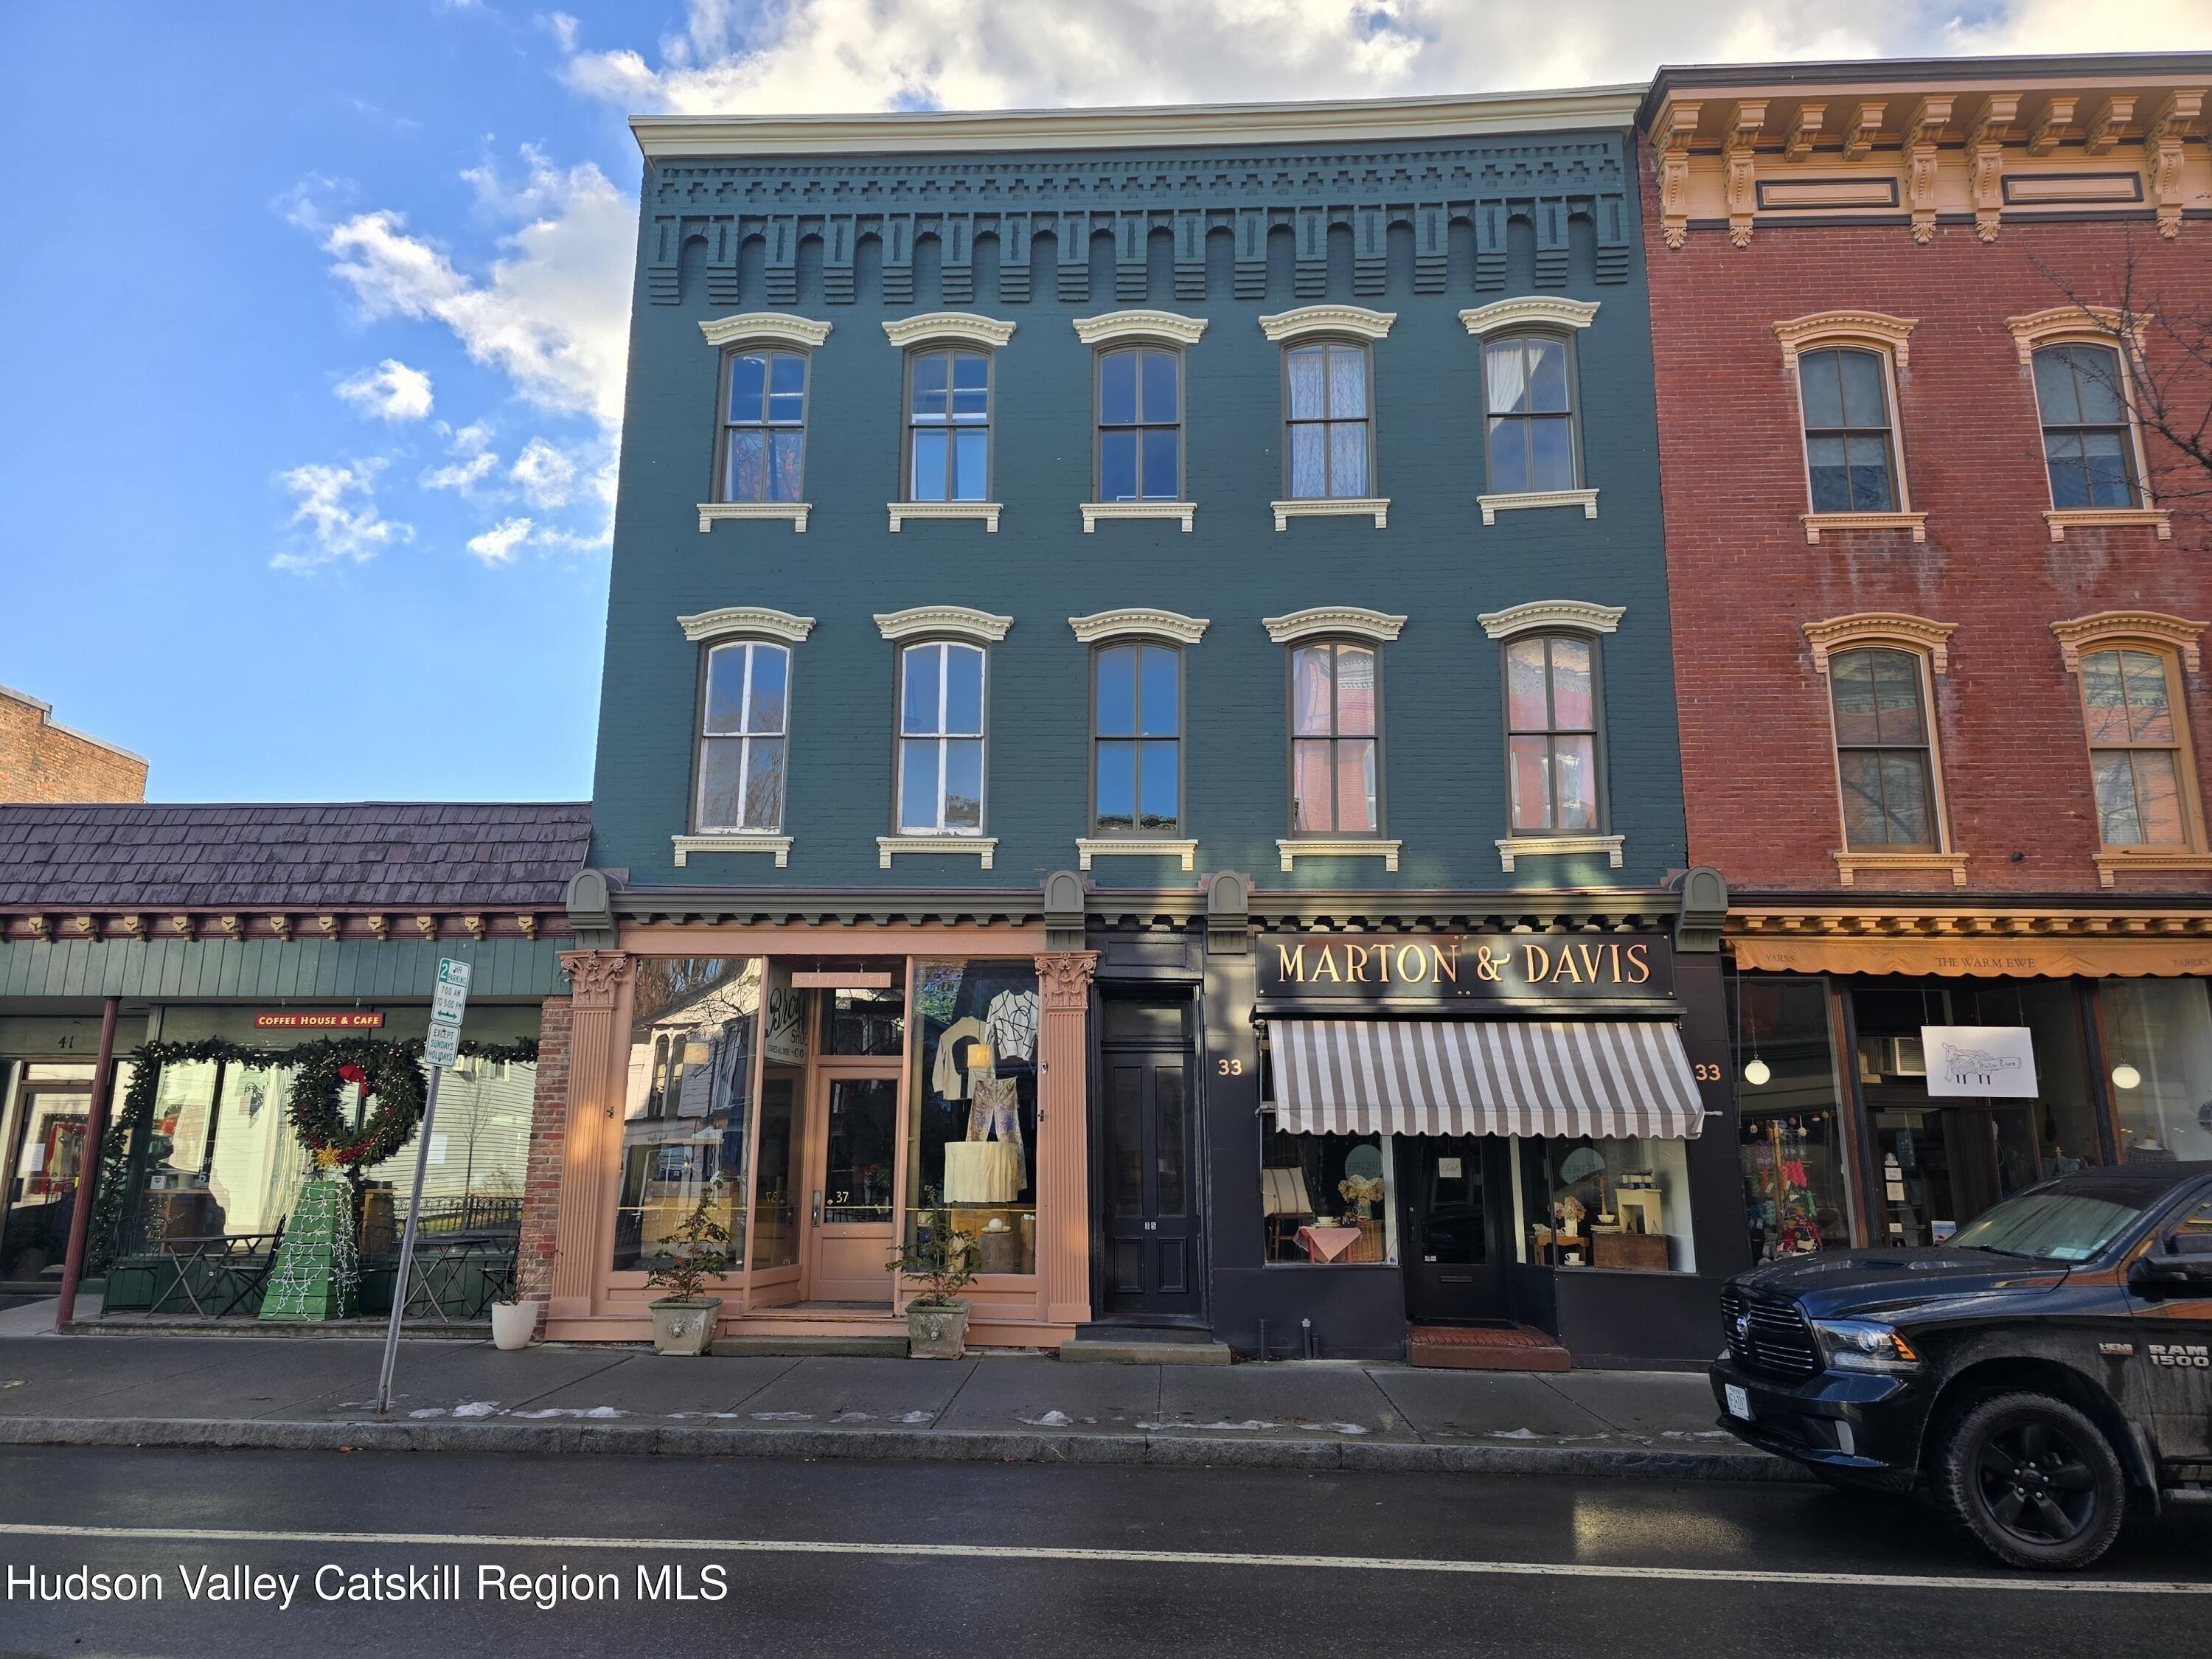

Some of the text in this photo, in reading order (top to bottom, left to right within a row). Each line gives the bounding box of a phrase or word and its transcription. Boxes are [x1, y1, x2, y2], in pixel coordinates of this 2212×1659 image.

[1277, 944, 1651, 984] MARTON & DAVIS
[1765, 954, 1796, 962] YARNS
[1935, 957, 2036, 968] THE WARM EWE
[439, 963, 448, 979] 2
[454, 965, 462, 974] HR
[447, 973, 467, 986] PARKING
[442, 985, 461, 998] 7:00 AM
[437, 997, 462, 1010] TO 5:00 PM
[258, 1016, 379, 1025] COFFEE HOUSE & CAFE
[434, 1028, 454, 1040] EXCEPT
[790, 1029, 808, 1046] SHOE
[58, 1035, 74, 1048] 41
[430, 1039, 454, 1051] SUNDAYS
[428, 1051, 453, 1062] HOLIDAYS
[1218, 1059, 1242, 1076] 33
[1695, 1064, 1721, 1081] 33
[836, 1191, 849, 1203] 37
[2149, 1344, 2208, 1356] RAM
[2150, 1354, 2210, 1367] 1500
